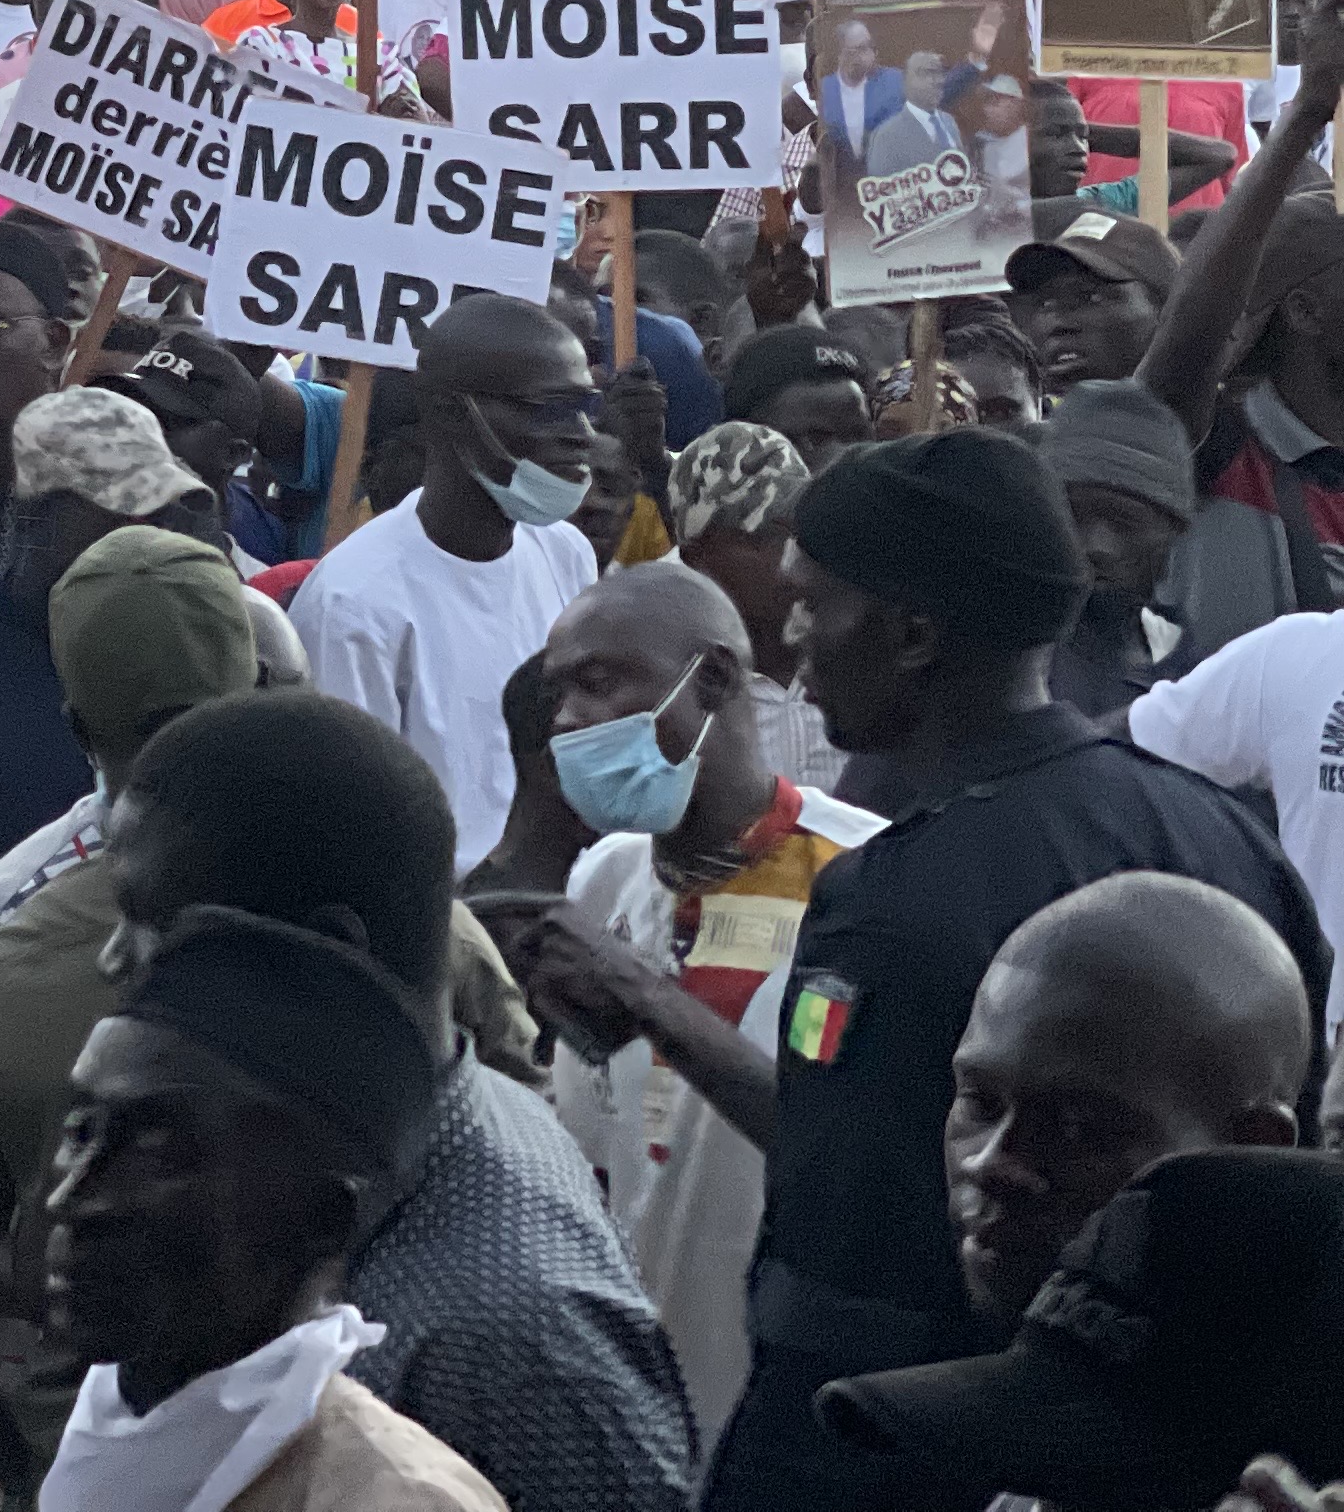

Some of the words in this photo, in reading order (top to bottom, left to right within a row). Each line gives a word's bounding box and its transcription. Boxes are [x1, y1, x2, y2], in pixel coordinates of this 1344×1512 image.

[53, 76, 231, 180] derriè
[488, 100, 752, 172] SARR
[0, 121, 163, 228] MOÏSE
[161, 188, 221, 257] SA
[235, 123, 554, 248] MOÏSE
[862, 166, 932, 203] Benno
[868, 186, 975, 235] Yaakaar
[240, 250, 500, 345] SAR
